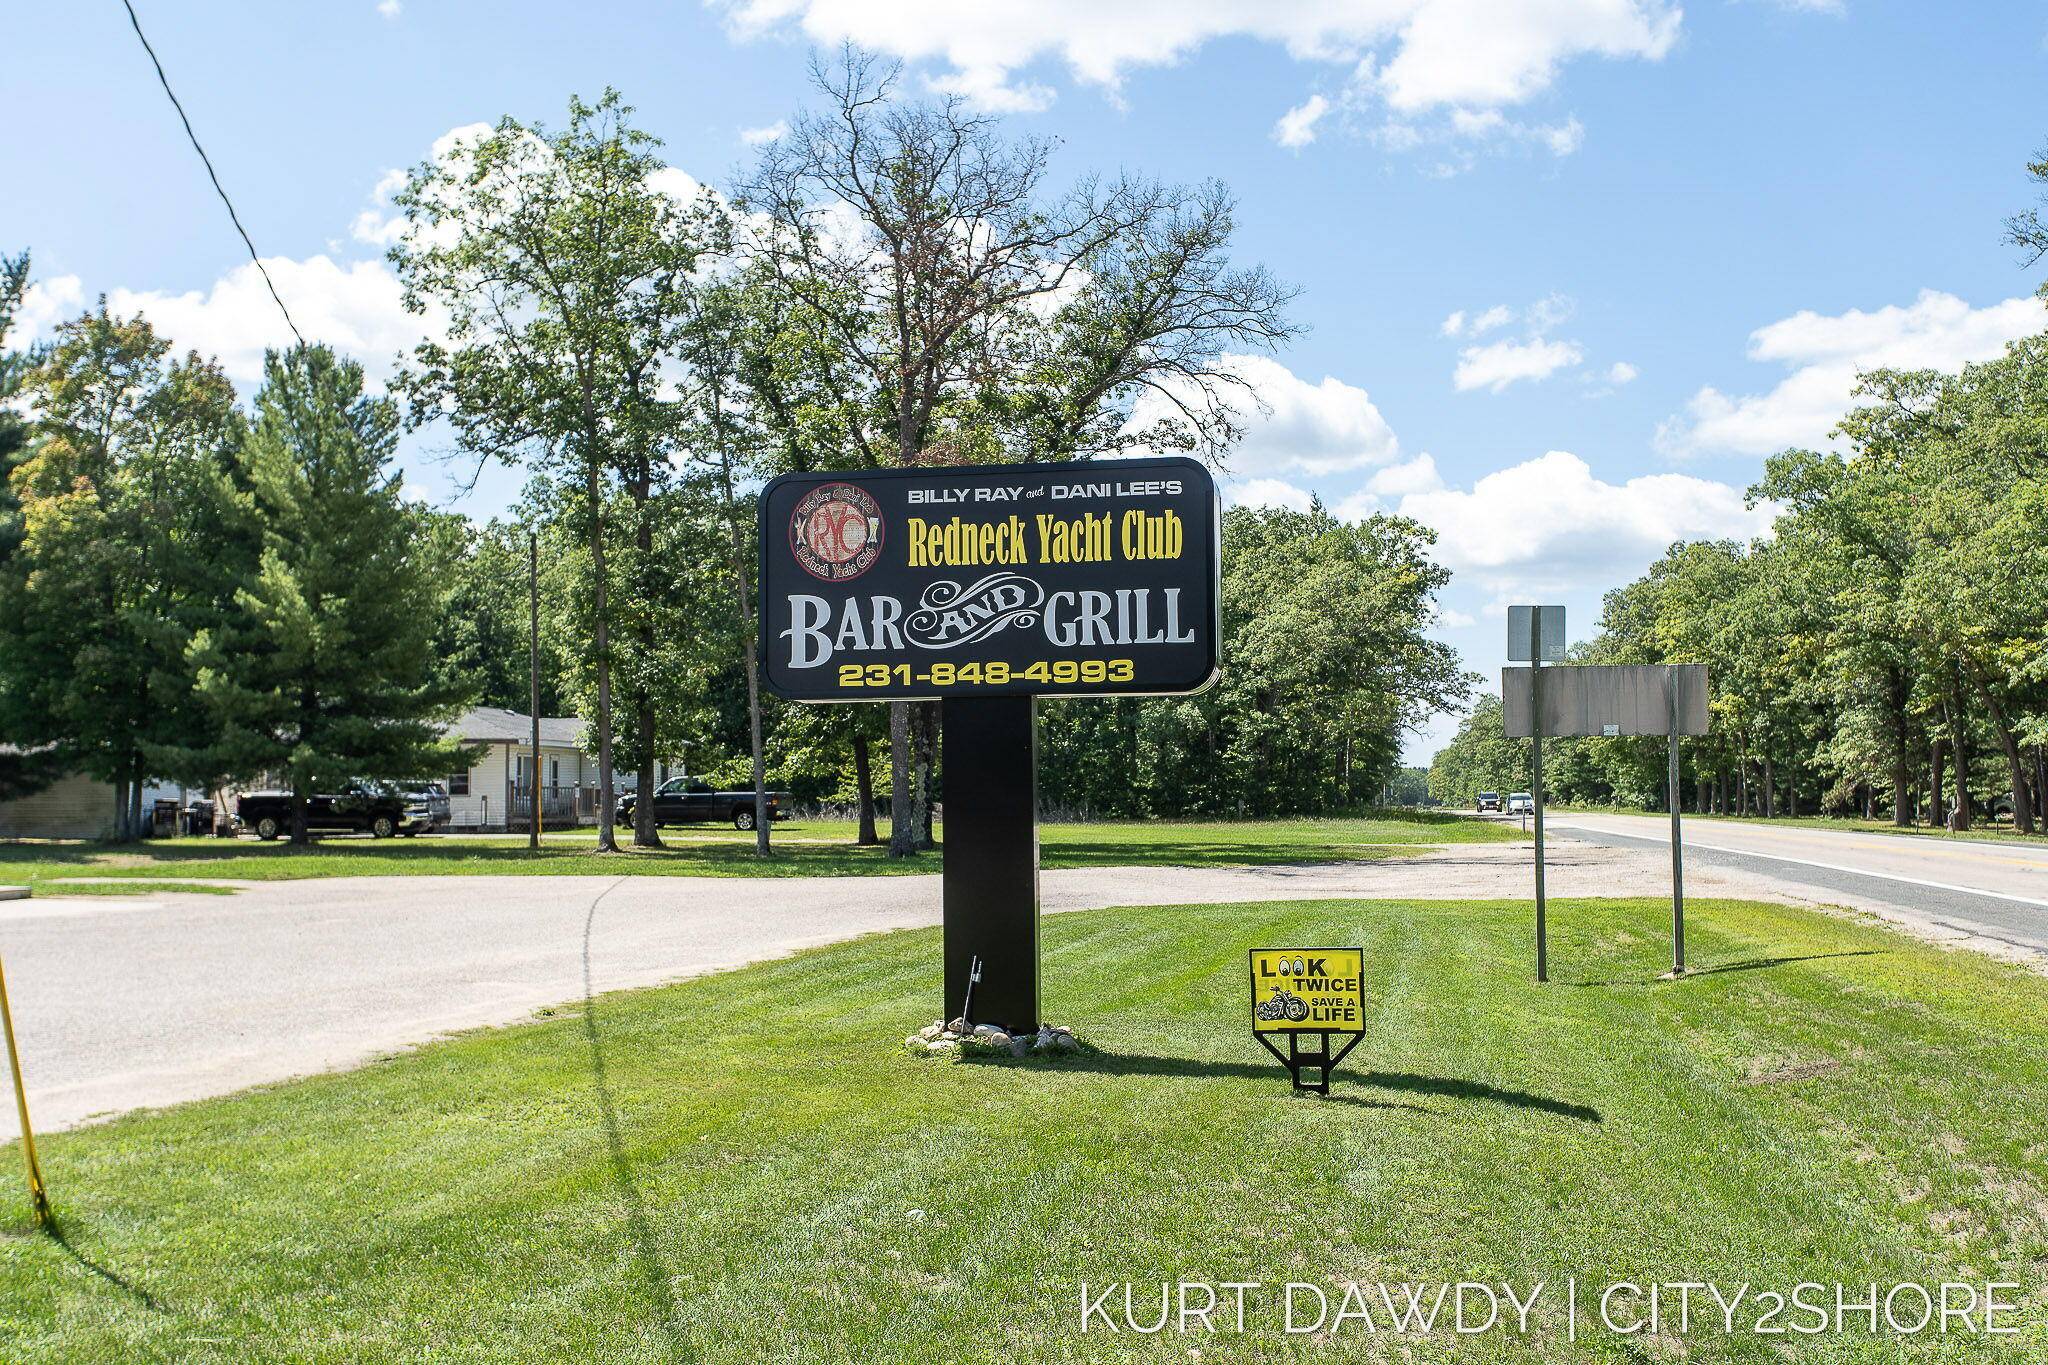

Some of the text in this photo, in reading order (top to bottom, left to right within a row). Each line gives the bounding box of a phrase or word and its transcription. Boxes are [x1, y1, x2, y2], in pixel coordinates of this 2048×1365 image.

[908, 480, 1183, 504] BILLY RAY and DANI LEE'S
[907, 509, 1183, 567] Redneck Yacht Club
[856, 546, 878, 569] Club
[779, 584, 1195, 669] BAR AND GRILL
[838, 659, 1135, 687] 231-848-4993
[1260, 958, 1328, 978] LOOK
[1292, 978, 1357, 992] TWICE
[1311, 997, 1356, 1007] SAVE A
[1312, 1007, 1356, 1022] LIFE
